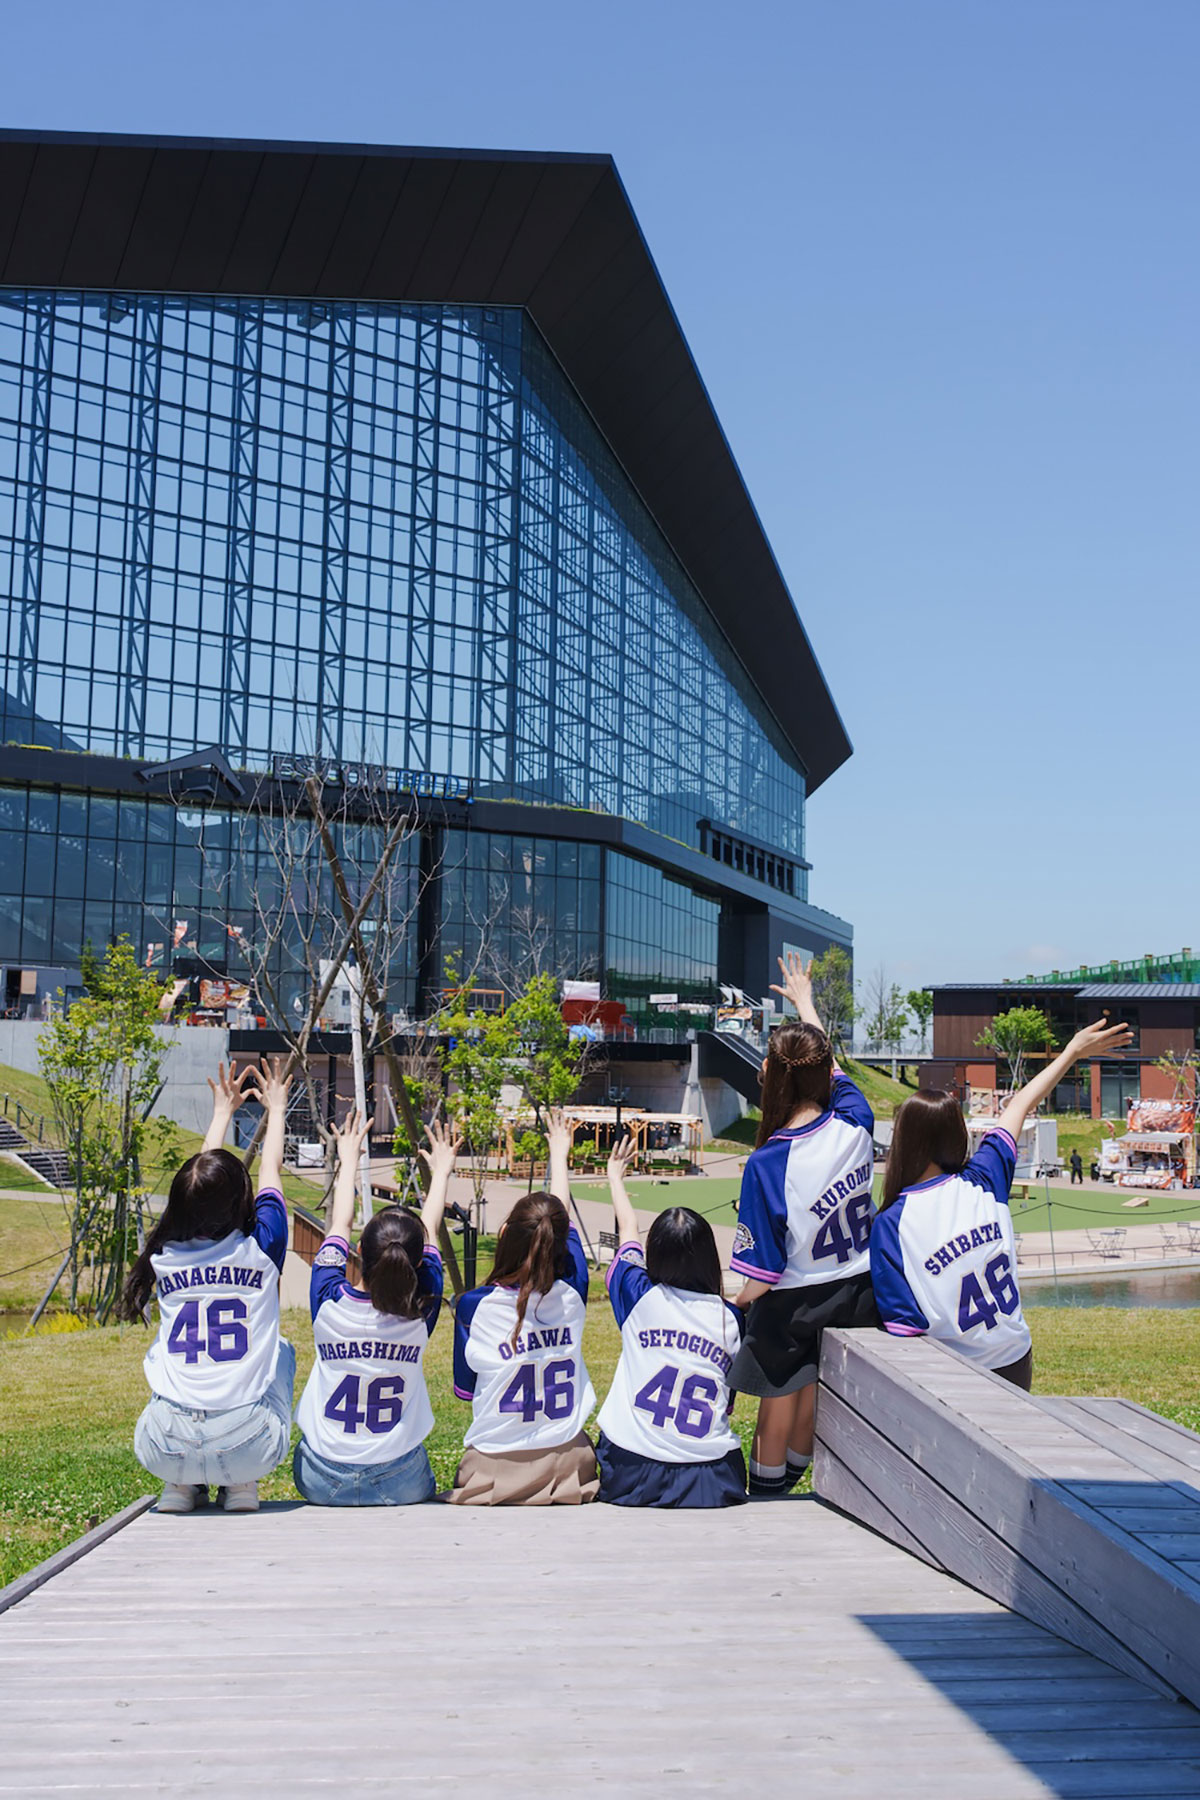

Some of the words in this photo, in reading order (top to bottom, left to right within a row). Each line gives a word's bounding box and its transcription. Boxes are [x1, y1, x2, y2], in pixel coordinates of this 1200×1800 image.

[398, 769, 460, 800] FIELD
[809, 1161, 871, 1221] KUROMI
[811, 1191, 873, 1264] 46
[924, 1221, 1003, 1276] SHIBATA
[957, 1252, 1020, 1333] 46
[167, 1297, 249, 1364] 46
[317, 1341, 421, 1364] NAGASHIMA
[498, 1327, 573, 1361] OGAWA
[324, 1374, 406, 1434] 46
[498, 1358, 576, 1423] 46
[634, 1365, 719, 1439] 46
